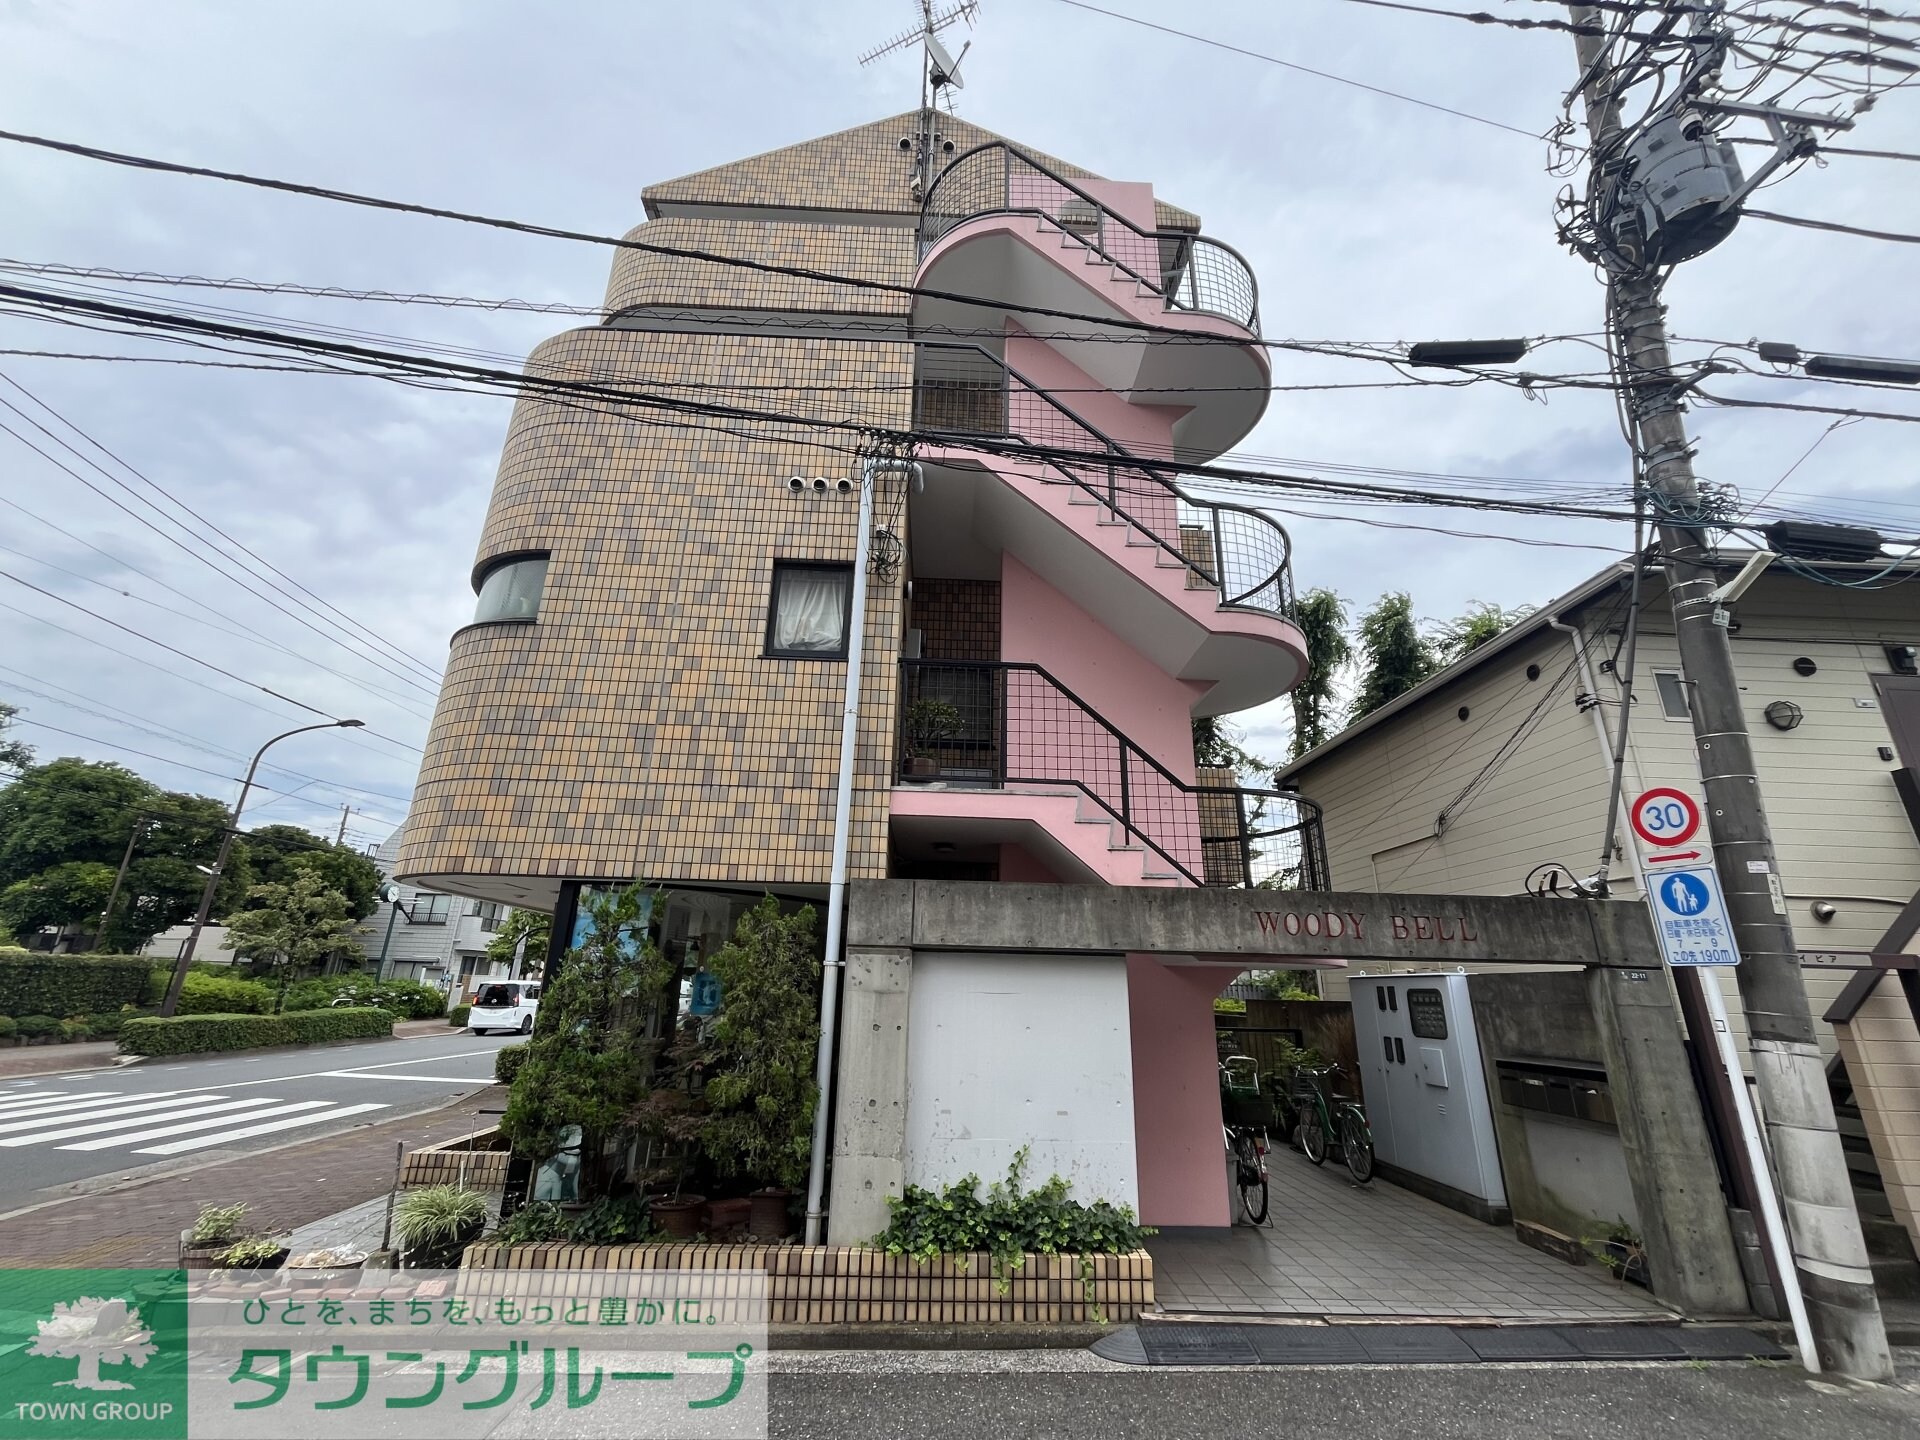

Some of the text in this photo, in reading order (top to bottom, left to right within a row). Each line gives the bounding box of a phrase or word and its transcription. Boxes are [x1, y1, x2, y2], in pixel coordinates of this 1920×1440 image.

[1645, 803, 1685, 831] 30
[1254, 911, 1478, 942] WOODY BELL
